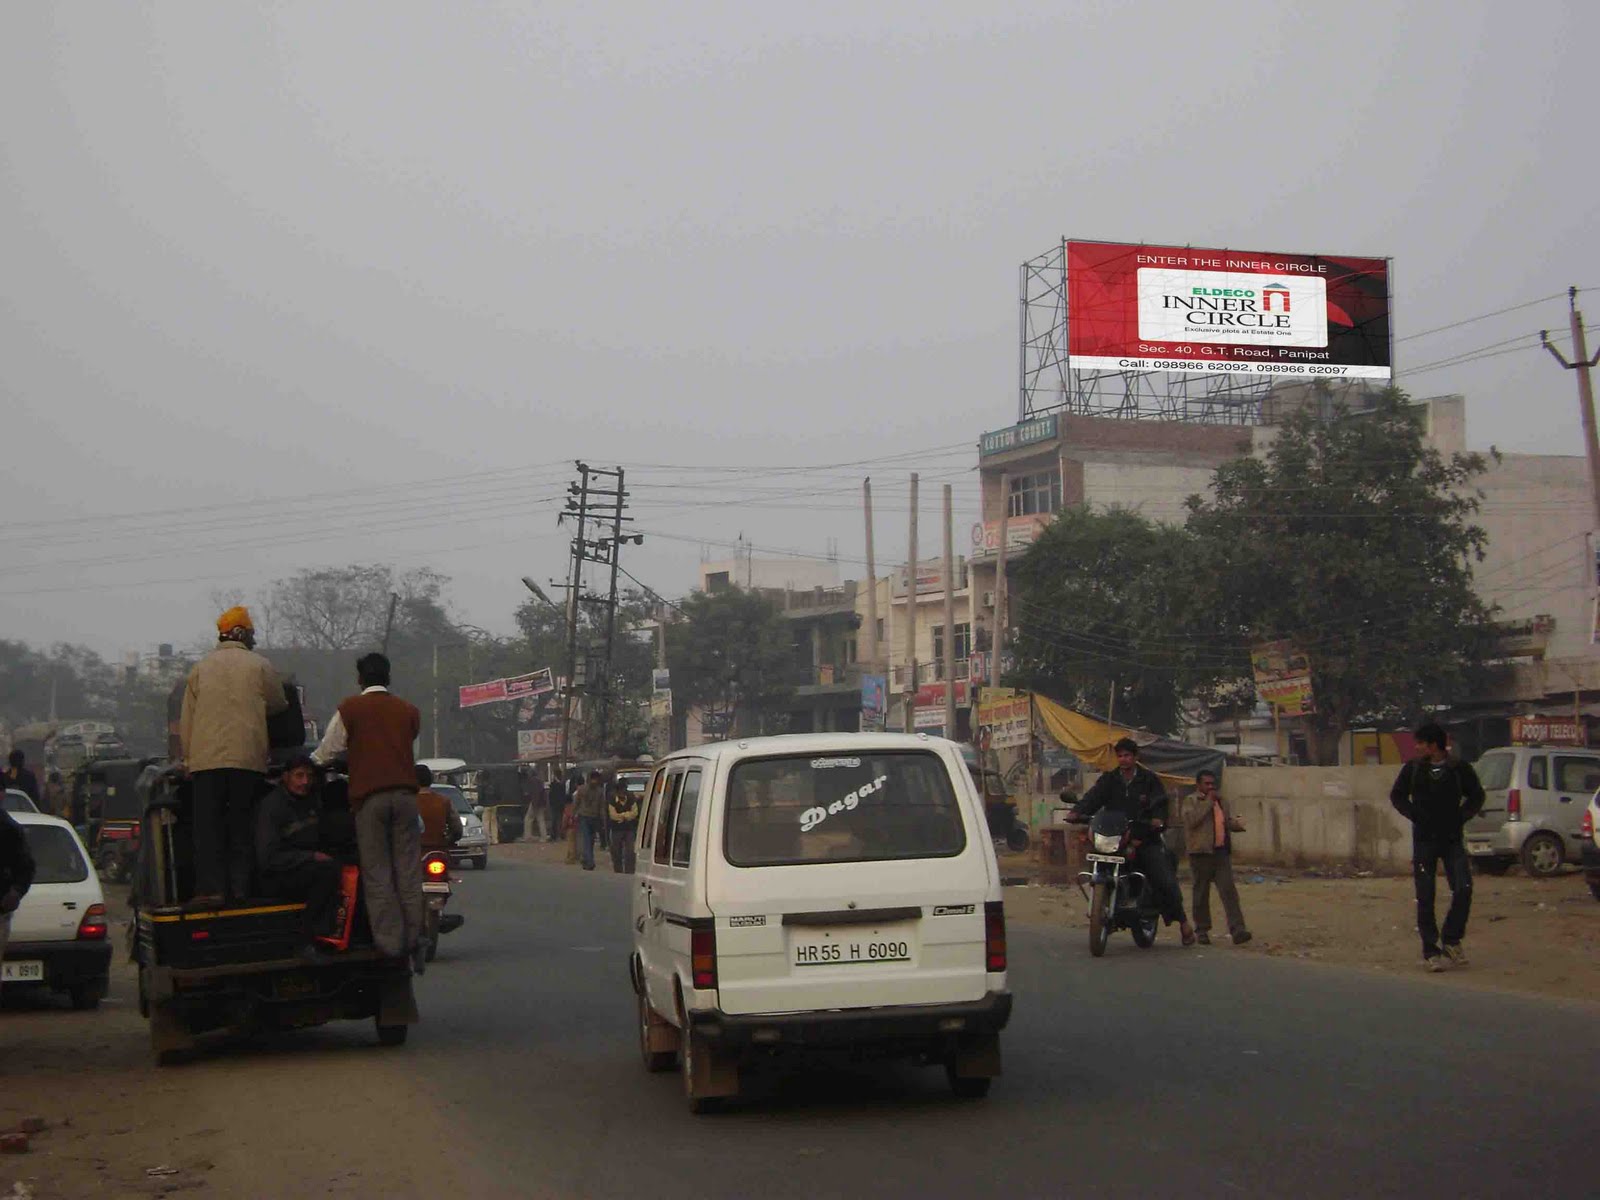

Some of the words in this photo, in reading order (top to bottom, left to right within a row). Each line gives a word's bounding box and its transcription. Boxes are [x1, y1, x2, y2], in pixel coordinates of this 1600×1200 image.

[1137, 255, 1188, 266] ENTER
[1192, 258, 1221, 267] THE
[1226, 260, 1271, 270] INNER
[1274, 262, 1327, 273] CIRCLE
[1192, 287, 1255, 298] ELDECO
[1162, 295, 1257, 312] INNER
[1186, 311, 1291, 328] CIRCLE
[1184, 326, 1221, 334] Exclusive
[1138, 344, 1169, 354] Sec.
[1234, 348, 1274, 358] Road,
[1279, 350, 1330, 360] Panipat
[1119, 359, 1149, 368] Call:
[1153, 360, 1203, 370] 098966
[1208, 362, 1252, 373] 62092,
[1256, 364, 1305, 374] 098966
[1308, 366, 1348, 375] 62097
[800, 775, 887, 832] Dagar
[797, 944, 840, 961] HR55
[850, 944, 860, 959] H
[868, 942, 908, 959] 6090
